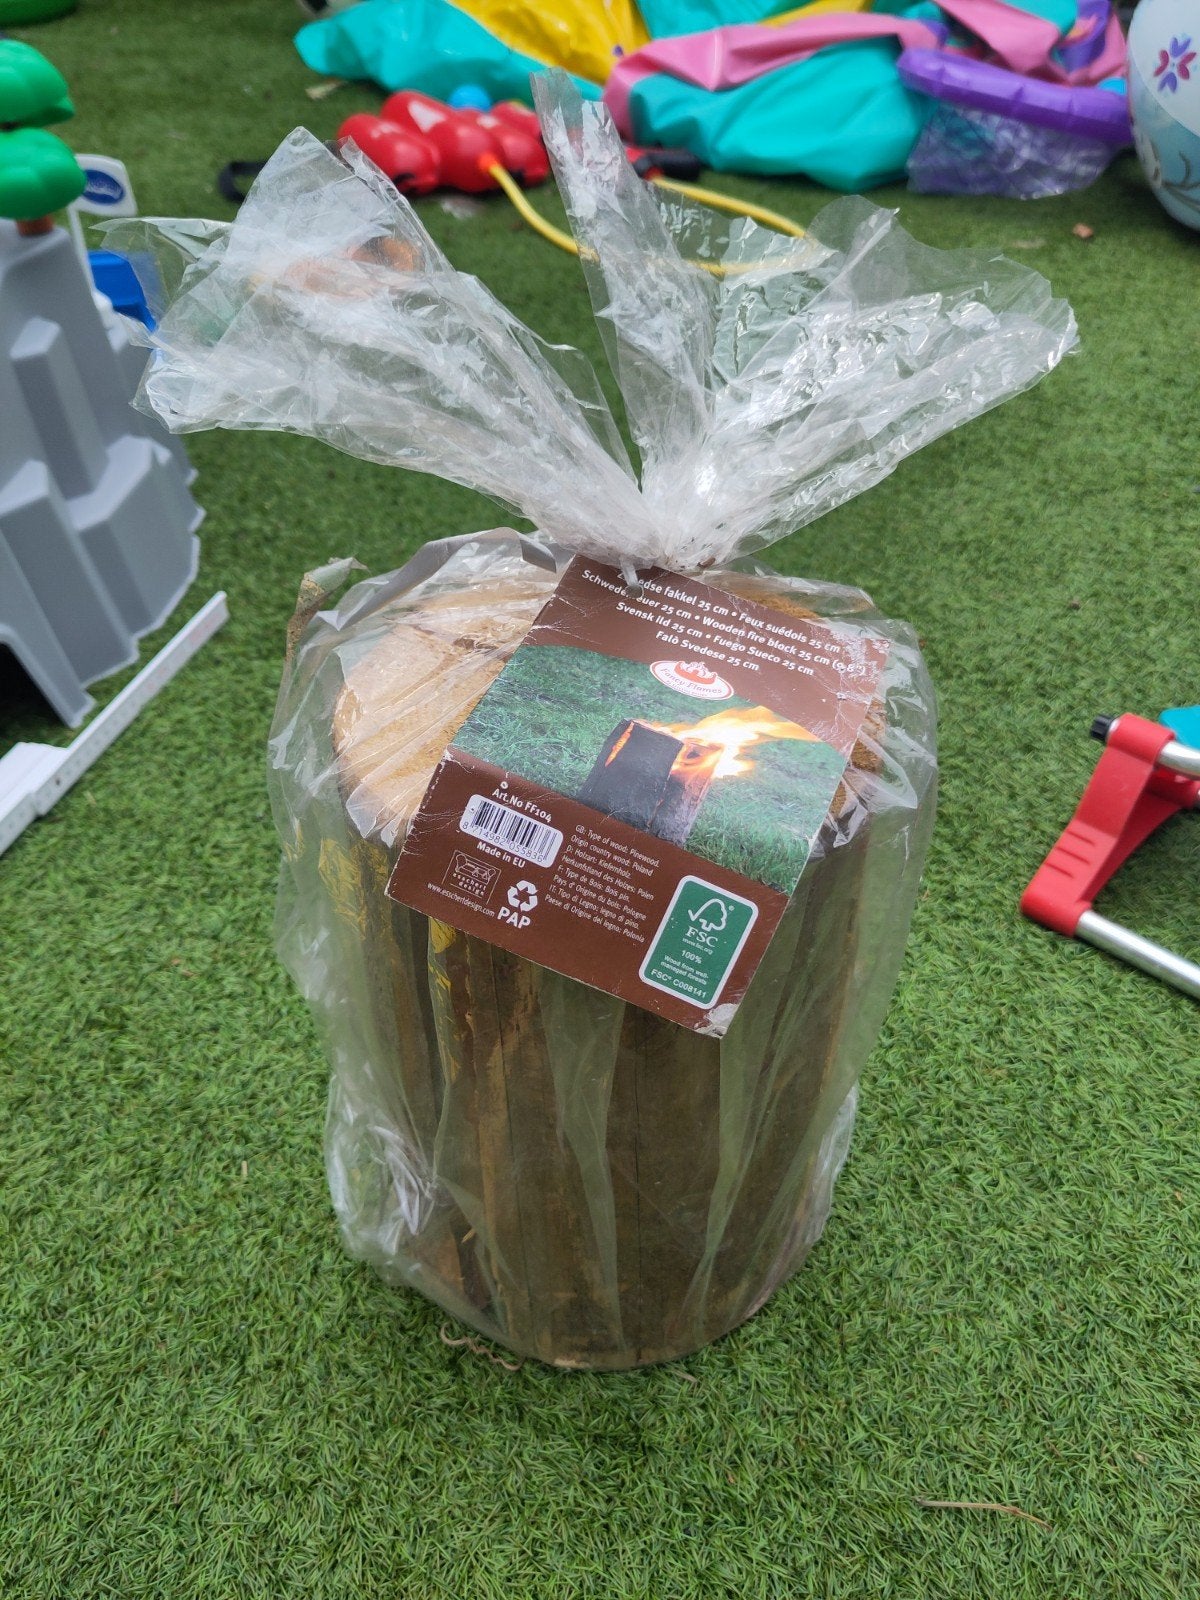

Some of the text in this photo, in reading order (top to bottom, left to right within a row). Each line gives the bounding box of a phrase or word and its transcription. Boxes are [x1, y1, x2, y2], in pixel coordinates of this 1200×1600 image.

[581, 569, 661, 608] Schwedeeuer
[660, 604, 675, 615] 25
[675, 609, 692, 620] cm
[702, 616, 746, 637] Wooden
[747, 631, 766, 644] fire
[767, 638, 798, 655] block
[798, 650, 812, 661] 25
[813, 655, 830, 666] cm
[664, 586, 697, 606] fakkel
[697, 600, 711, 612] 25
[713, 605, 729, 616] cm
[739, 612, 765, 629] Feux
[765, 623, 807, 643] suédois
[808, 638, 822, 650] 25
[824, 643, 841, 653] cm
[616, 601, 655, 622] Svensk
[671, 622, 686, 633] 25
[686, 627, 703, 638] cm
[713, 634, 746, 652] Fuego
[747, 645, 781, 663] Sueco
[781, 659, 797, 670] 25
[797, 665, 815, 676] cm
[656, 630, 760, 671] Falò Svedese 25 cm
[660, 668, 686, 686] Fancy
[686, 681, 722, 694] Flames
[524, 801, 552, 823] FF104
[462, 821, 469, 830] 8
[508, 842, 544, 863] 055836
[476, 841, 526, 868] Made in EU
[571, 834, 589, 847] Origin
[590, 844, 612, 858] country
[632, 861, 654, 876] Poland
[588, 829, 601, 841] Type
[610, 841, 628, 853] wood:
[566, 867, 579, 879] Type
[580, 874, 588, 883] de
[605, 885, 619, 897] Bois
[602, 873, 614, 883] des
[637, 887, 654, 901] Polen
[553, 874, 568, 887] Pays
[575, 884, 597, 899] Origine
[597, 894, 606, 903] du
[622, 905, 647, 921] Pologne
[558, 888, 571, 899] Tipo
[571, 894, 579, 903] di
[600, 906, 617, 919] legno
[617, 915, 625, 923] di
[497, 906, 531, 929] PAP
[544, 893, 563, 907] Paese
[563, 902, 571, 911] di
[570, 905, 592, 920] Origine
[592, 915, 603, 925] del
[622, 928, 645, 943] Polonia
[685, 925, 719, 948] FSC
[664, 955, 681, 967] Wood
[681, 963, 695, 973] from
[681, 949, 703, 964] 100%
[661, 961, 707, 985] managed forests
[672, 978, 707, 999] C008141
